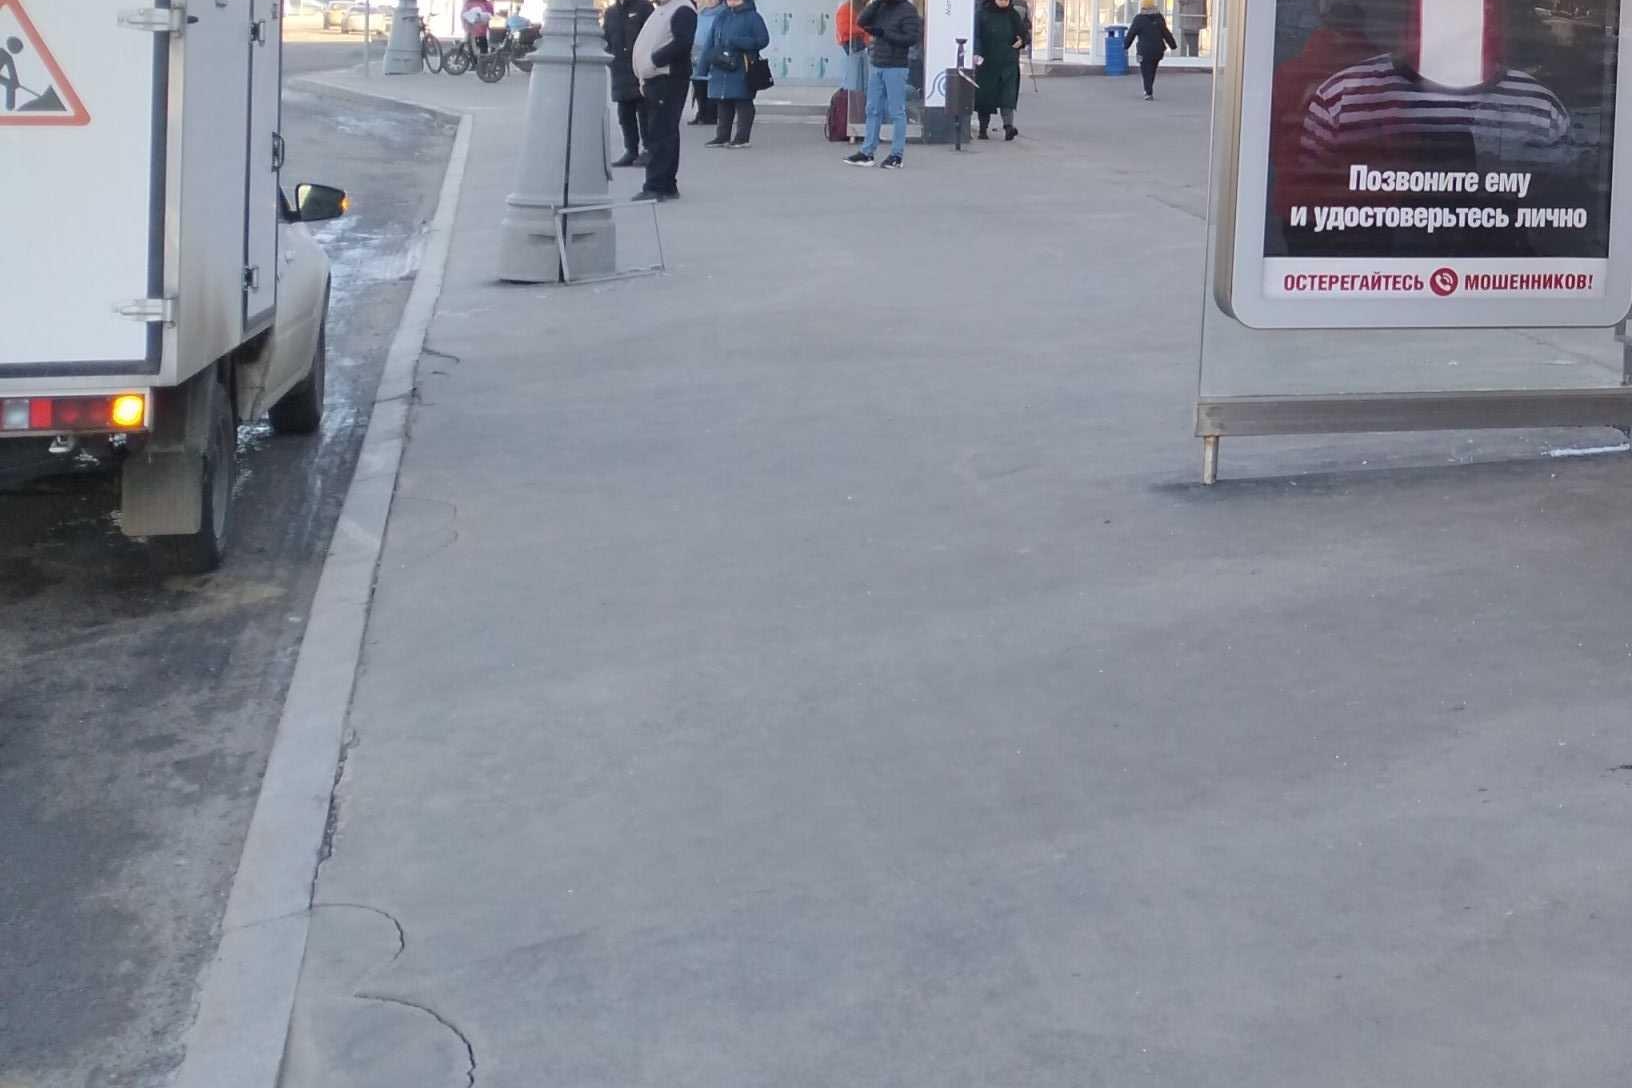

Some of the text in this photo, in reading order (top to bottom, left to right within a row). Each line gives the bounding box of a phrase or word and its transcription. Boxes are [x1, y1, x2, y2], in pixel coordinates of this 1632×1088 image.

[1349, 164, 1532, 198] Позвоните ему
[1290, 206, 1588, 233] и удостоверьтесь лично
[1284, 271, 1593, 292] ОСТЕРЕГАЙТЕСЬ МОШЕННИКОВ!
